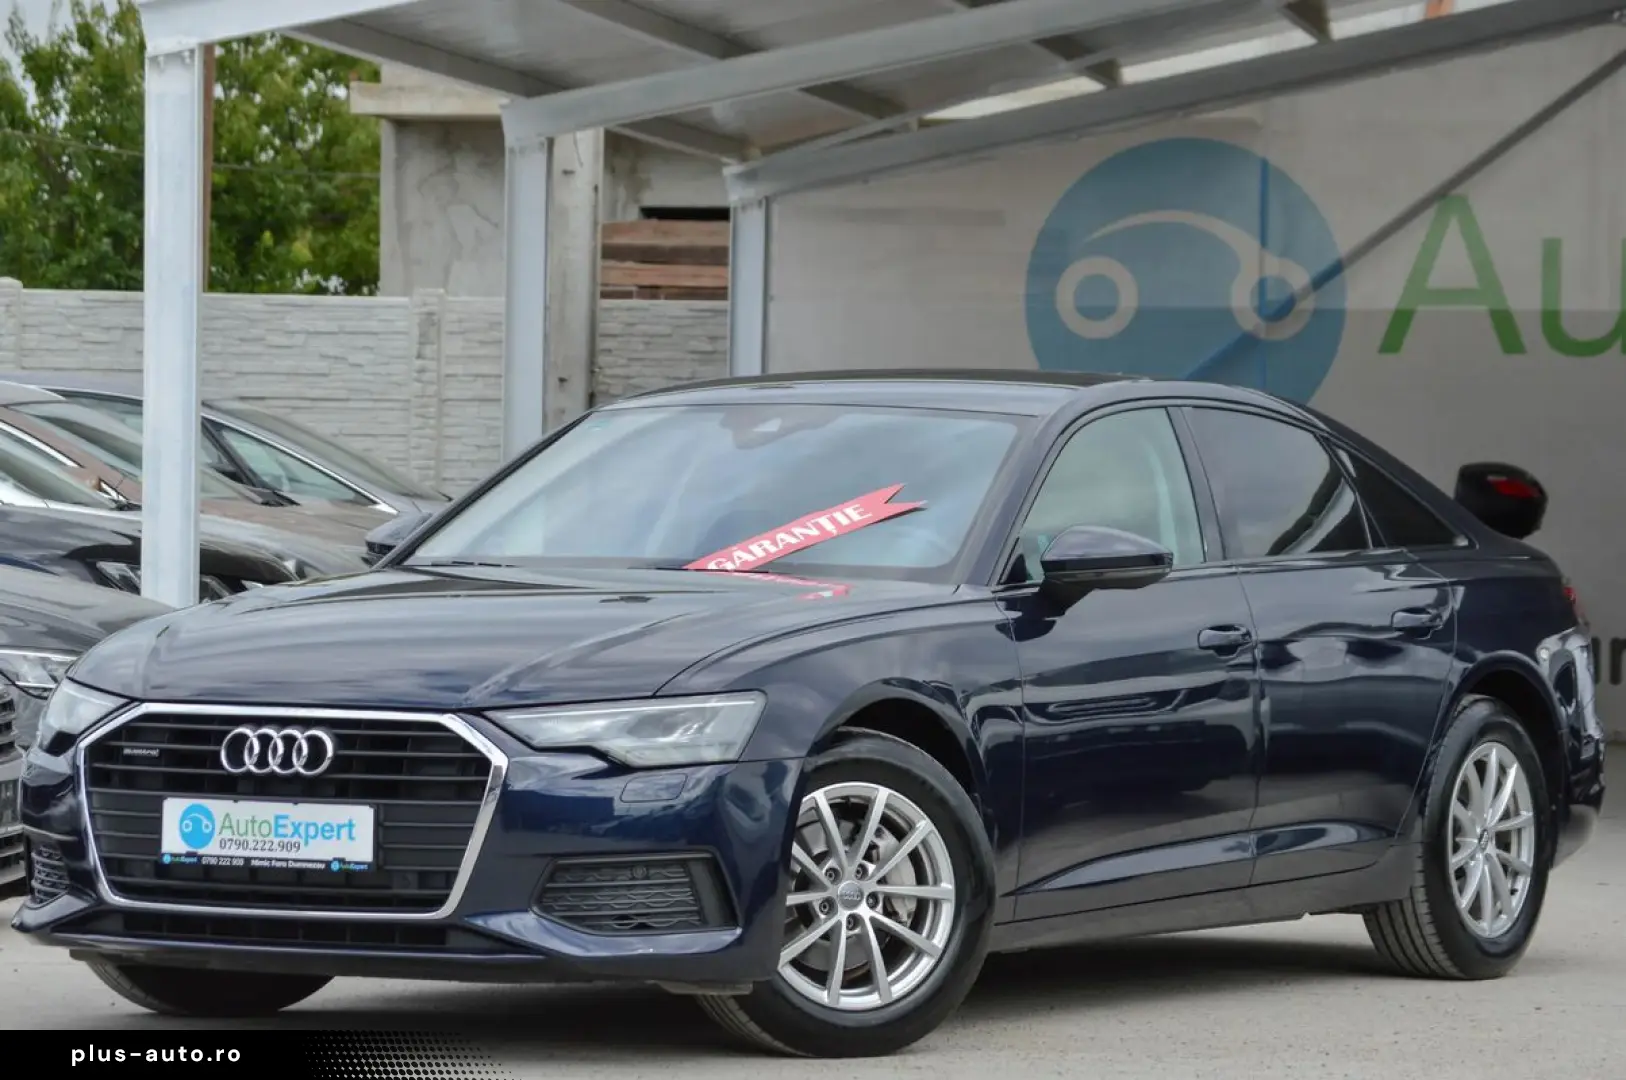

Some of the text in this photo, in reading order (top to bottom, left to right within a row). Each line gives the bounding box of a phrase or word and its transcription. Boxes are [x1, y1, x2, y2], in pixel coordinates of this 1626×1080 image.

[219, 812, 356, 847] AutoExpert
[219, 838, 301, 853] 0790.222.909
[219, 857, 231, 867] 222
